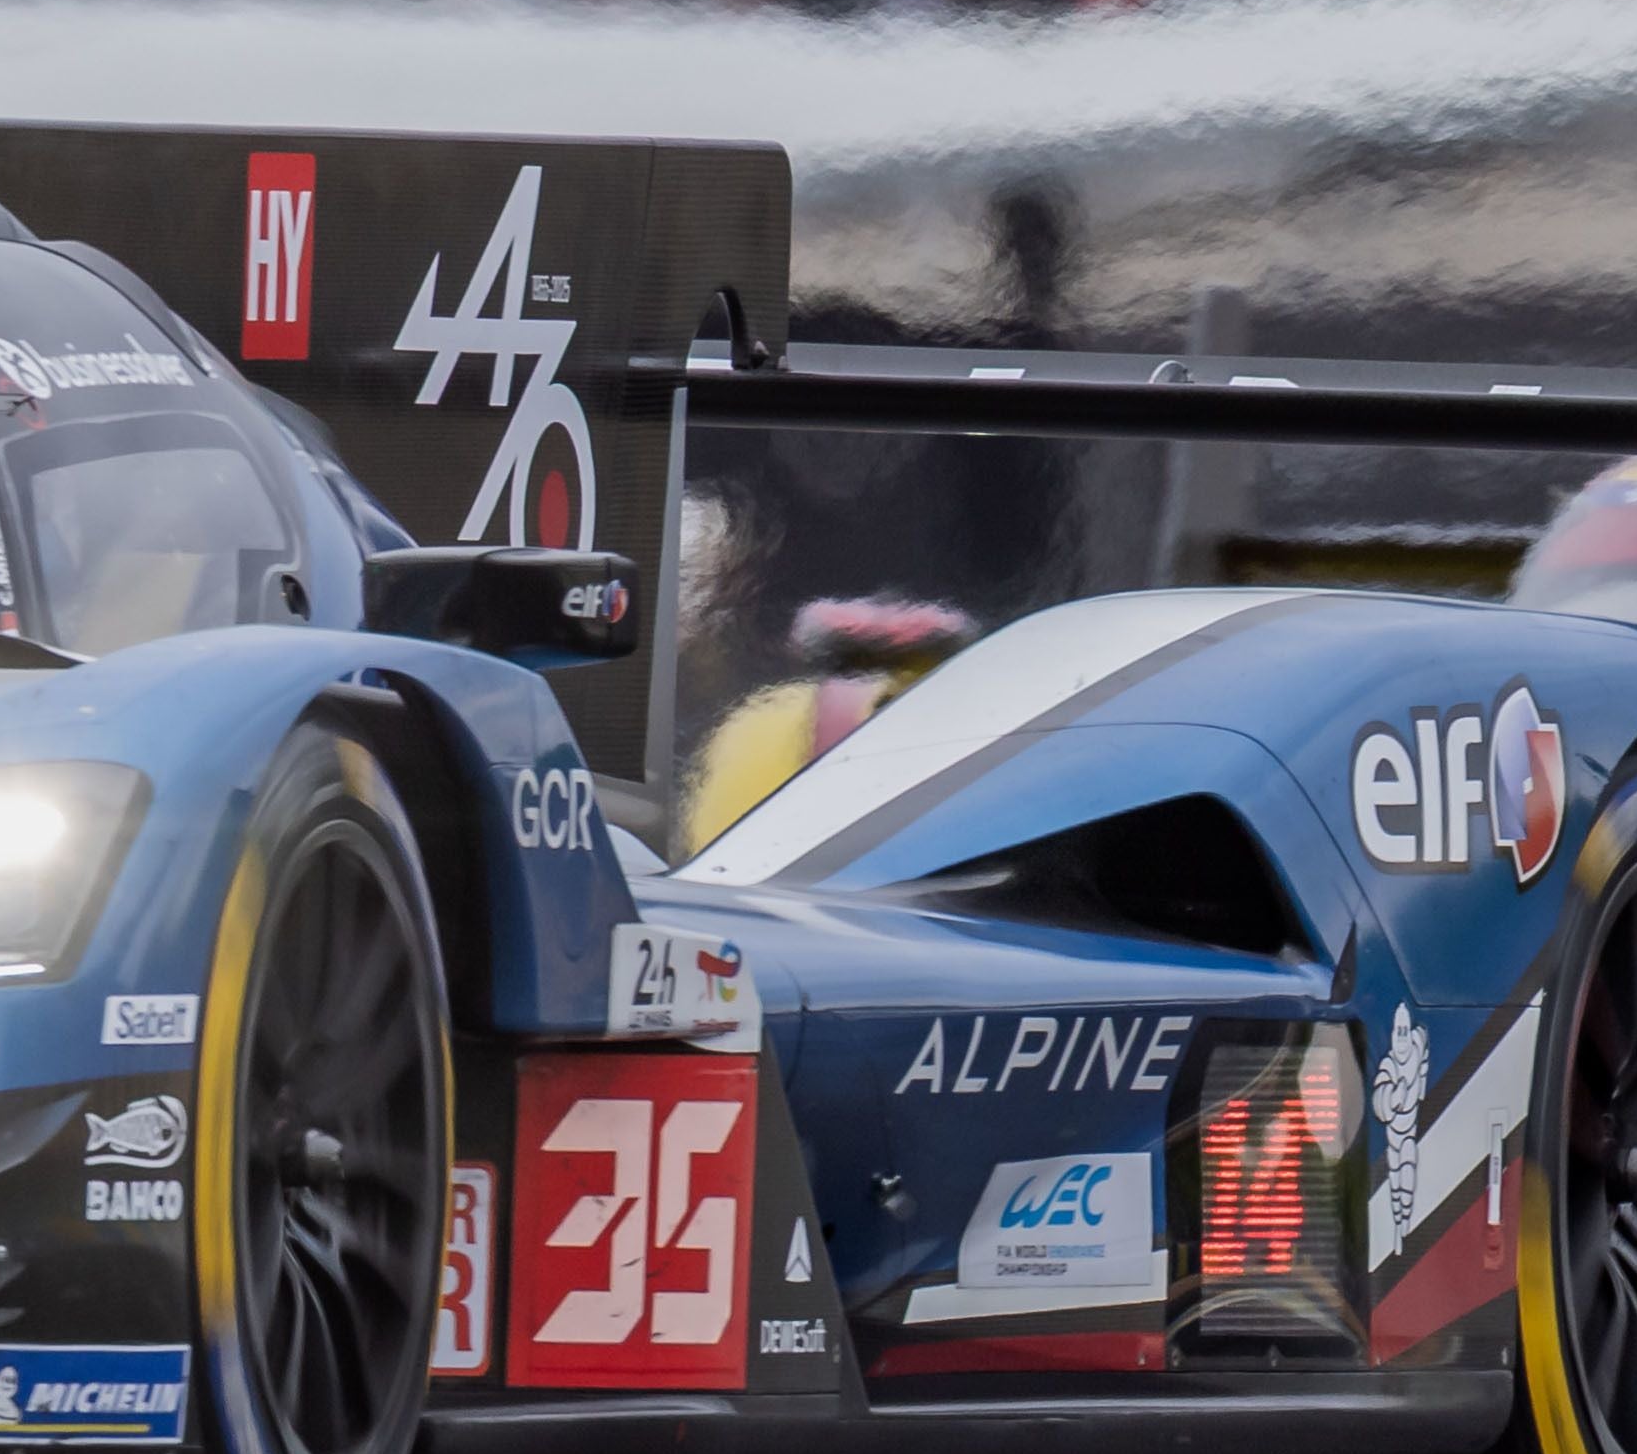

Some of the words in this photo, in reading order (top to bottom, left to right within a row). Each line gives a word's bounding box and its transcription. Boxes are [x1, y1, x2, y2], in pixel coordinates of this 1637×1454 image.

[246, 190, 312, 322] HY
[561, 583, 604, 619] elf
[512, 768, 594, 852] GCR
[1353, 716, 1484, 863] elf
[893, 1015, 1194, 1094] ALPINE
[84, 1180, 184, 1222] BAHCO
[532, 1098, 744, 1344] 35
[999, 1163, 1113, 1229] WEC
[24, 1381, 185, 1414] MICHELIN
